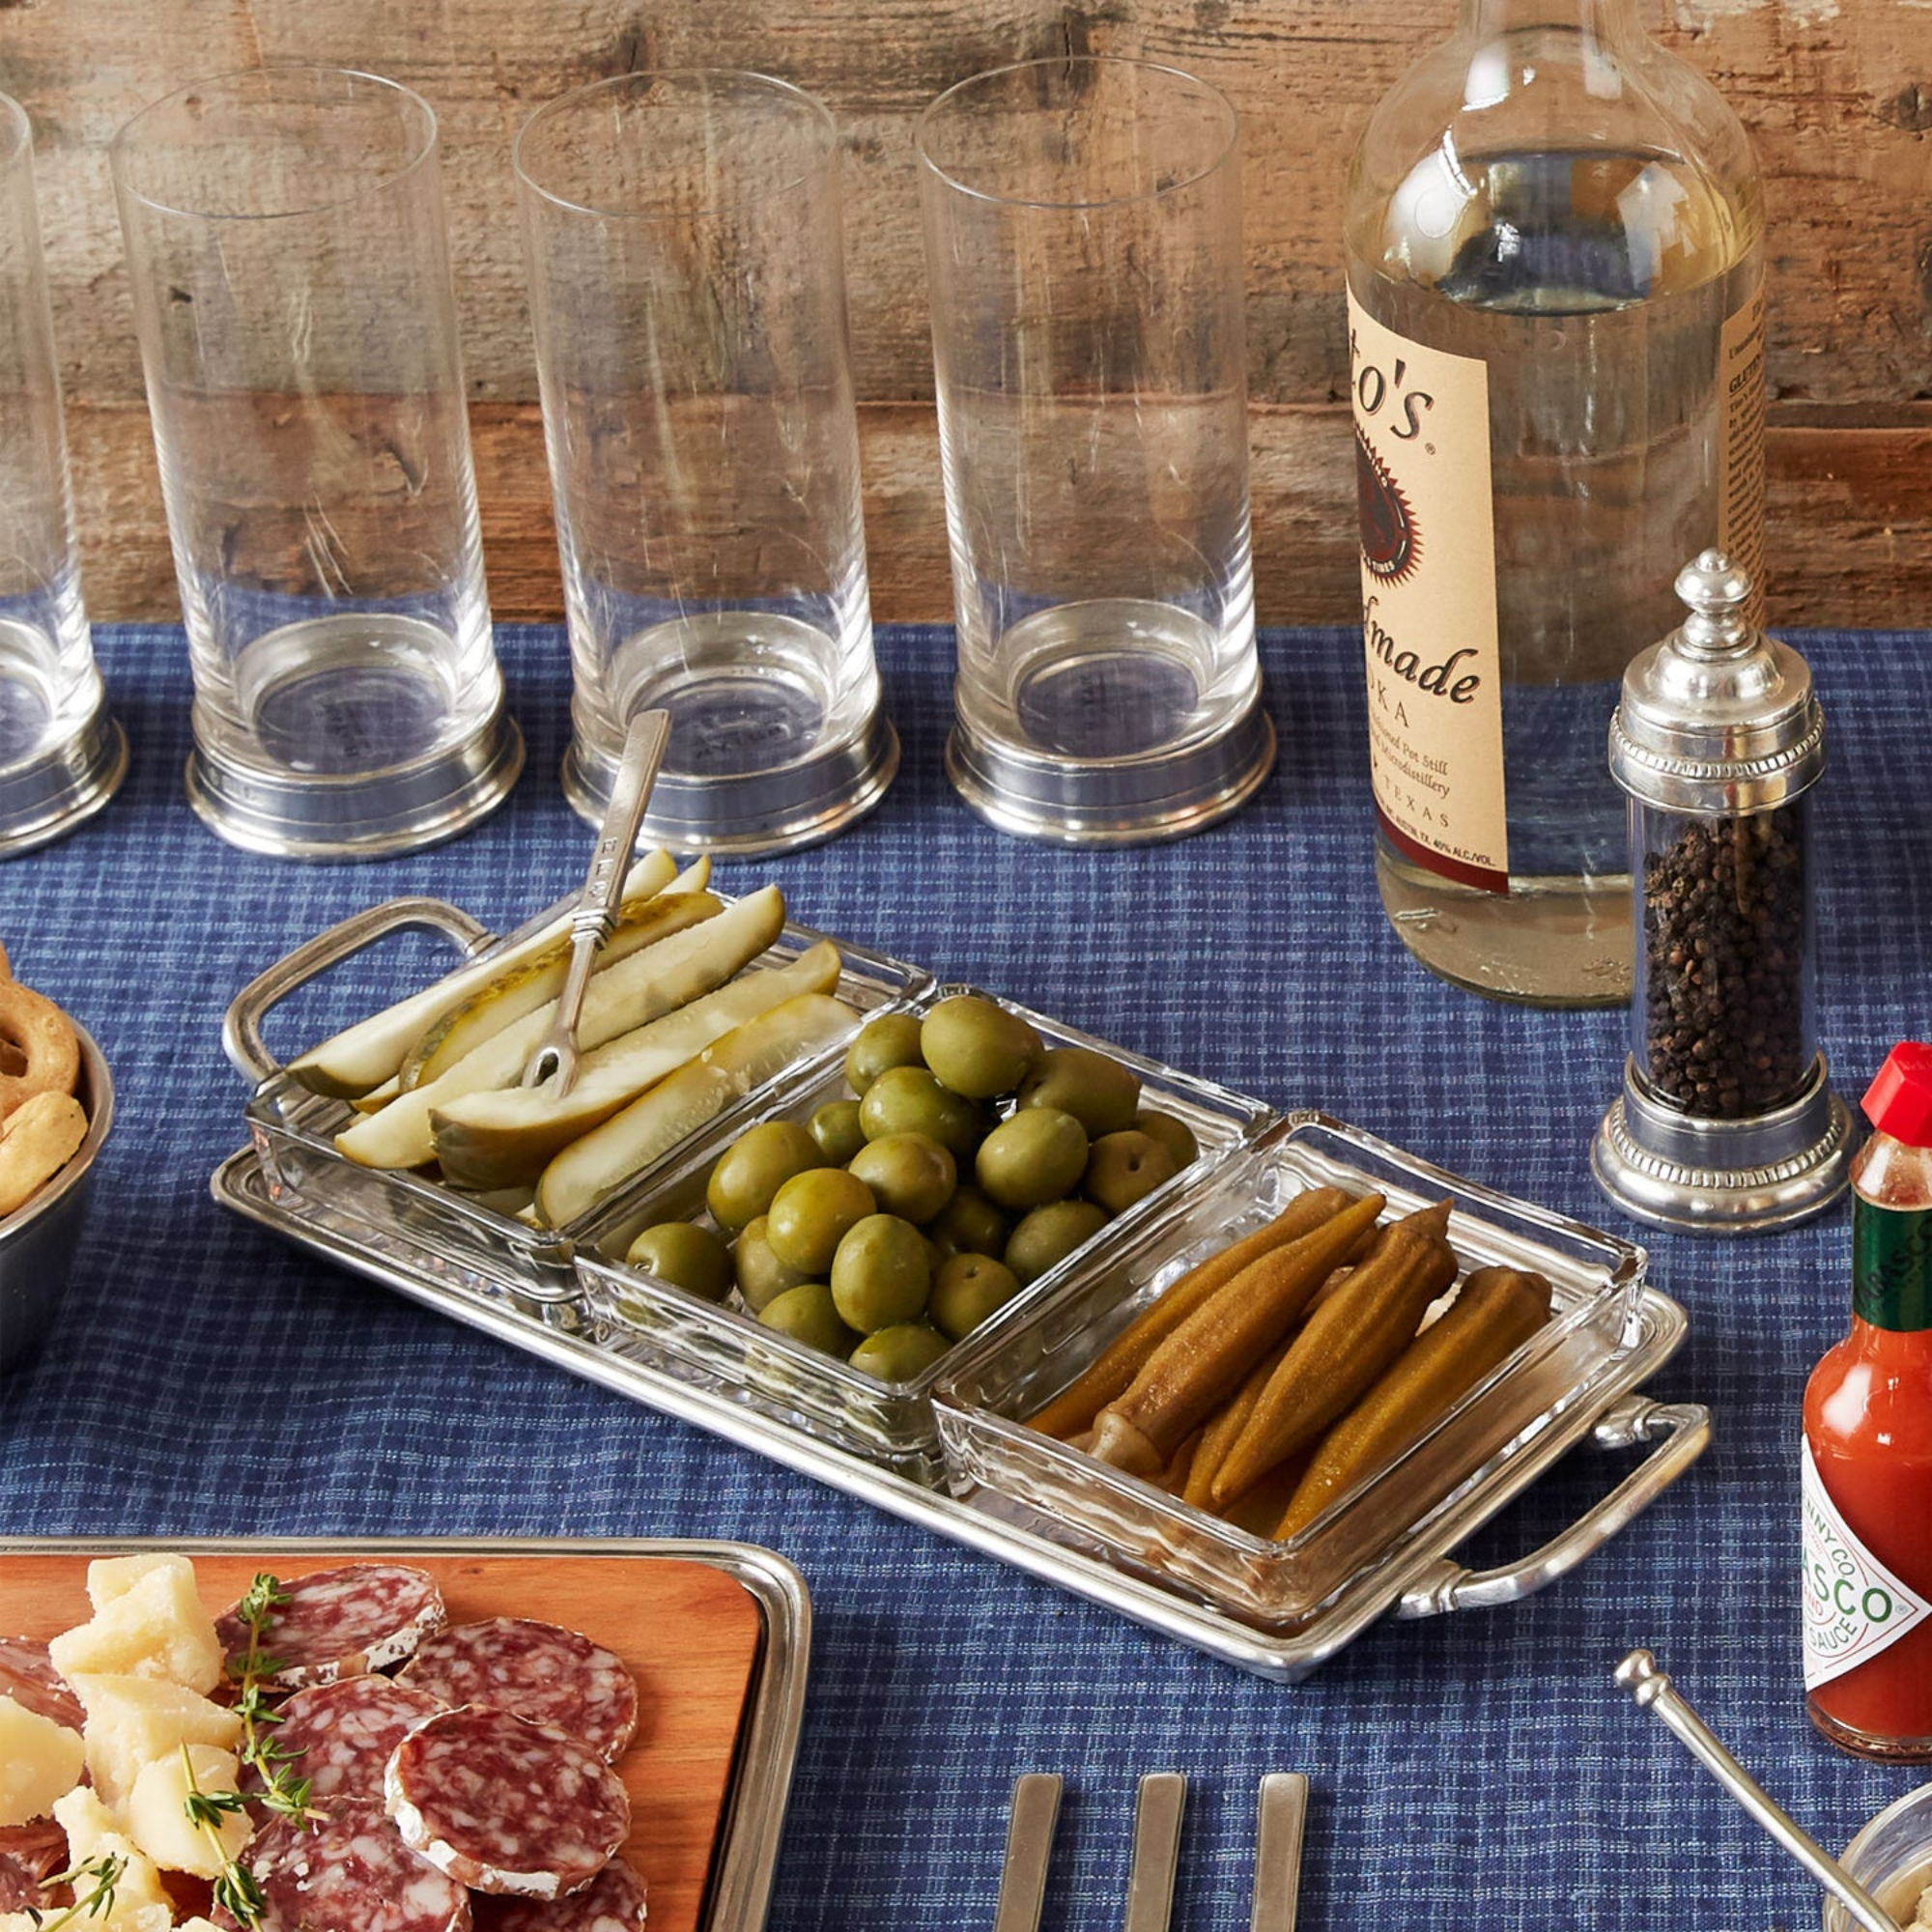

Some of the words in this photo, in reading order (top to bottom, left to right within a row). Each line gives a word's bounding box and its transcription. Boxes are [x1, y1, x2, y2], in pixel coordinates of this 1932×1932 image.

[1422, 753, 1450, 777] Still
[1382, 776, 1450, 829] TEXAS
[1808, 1617, 1859, 1651] SAUCE
